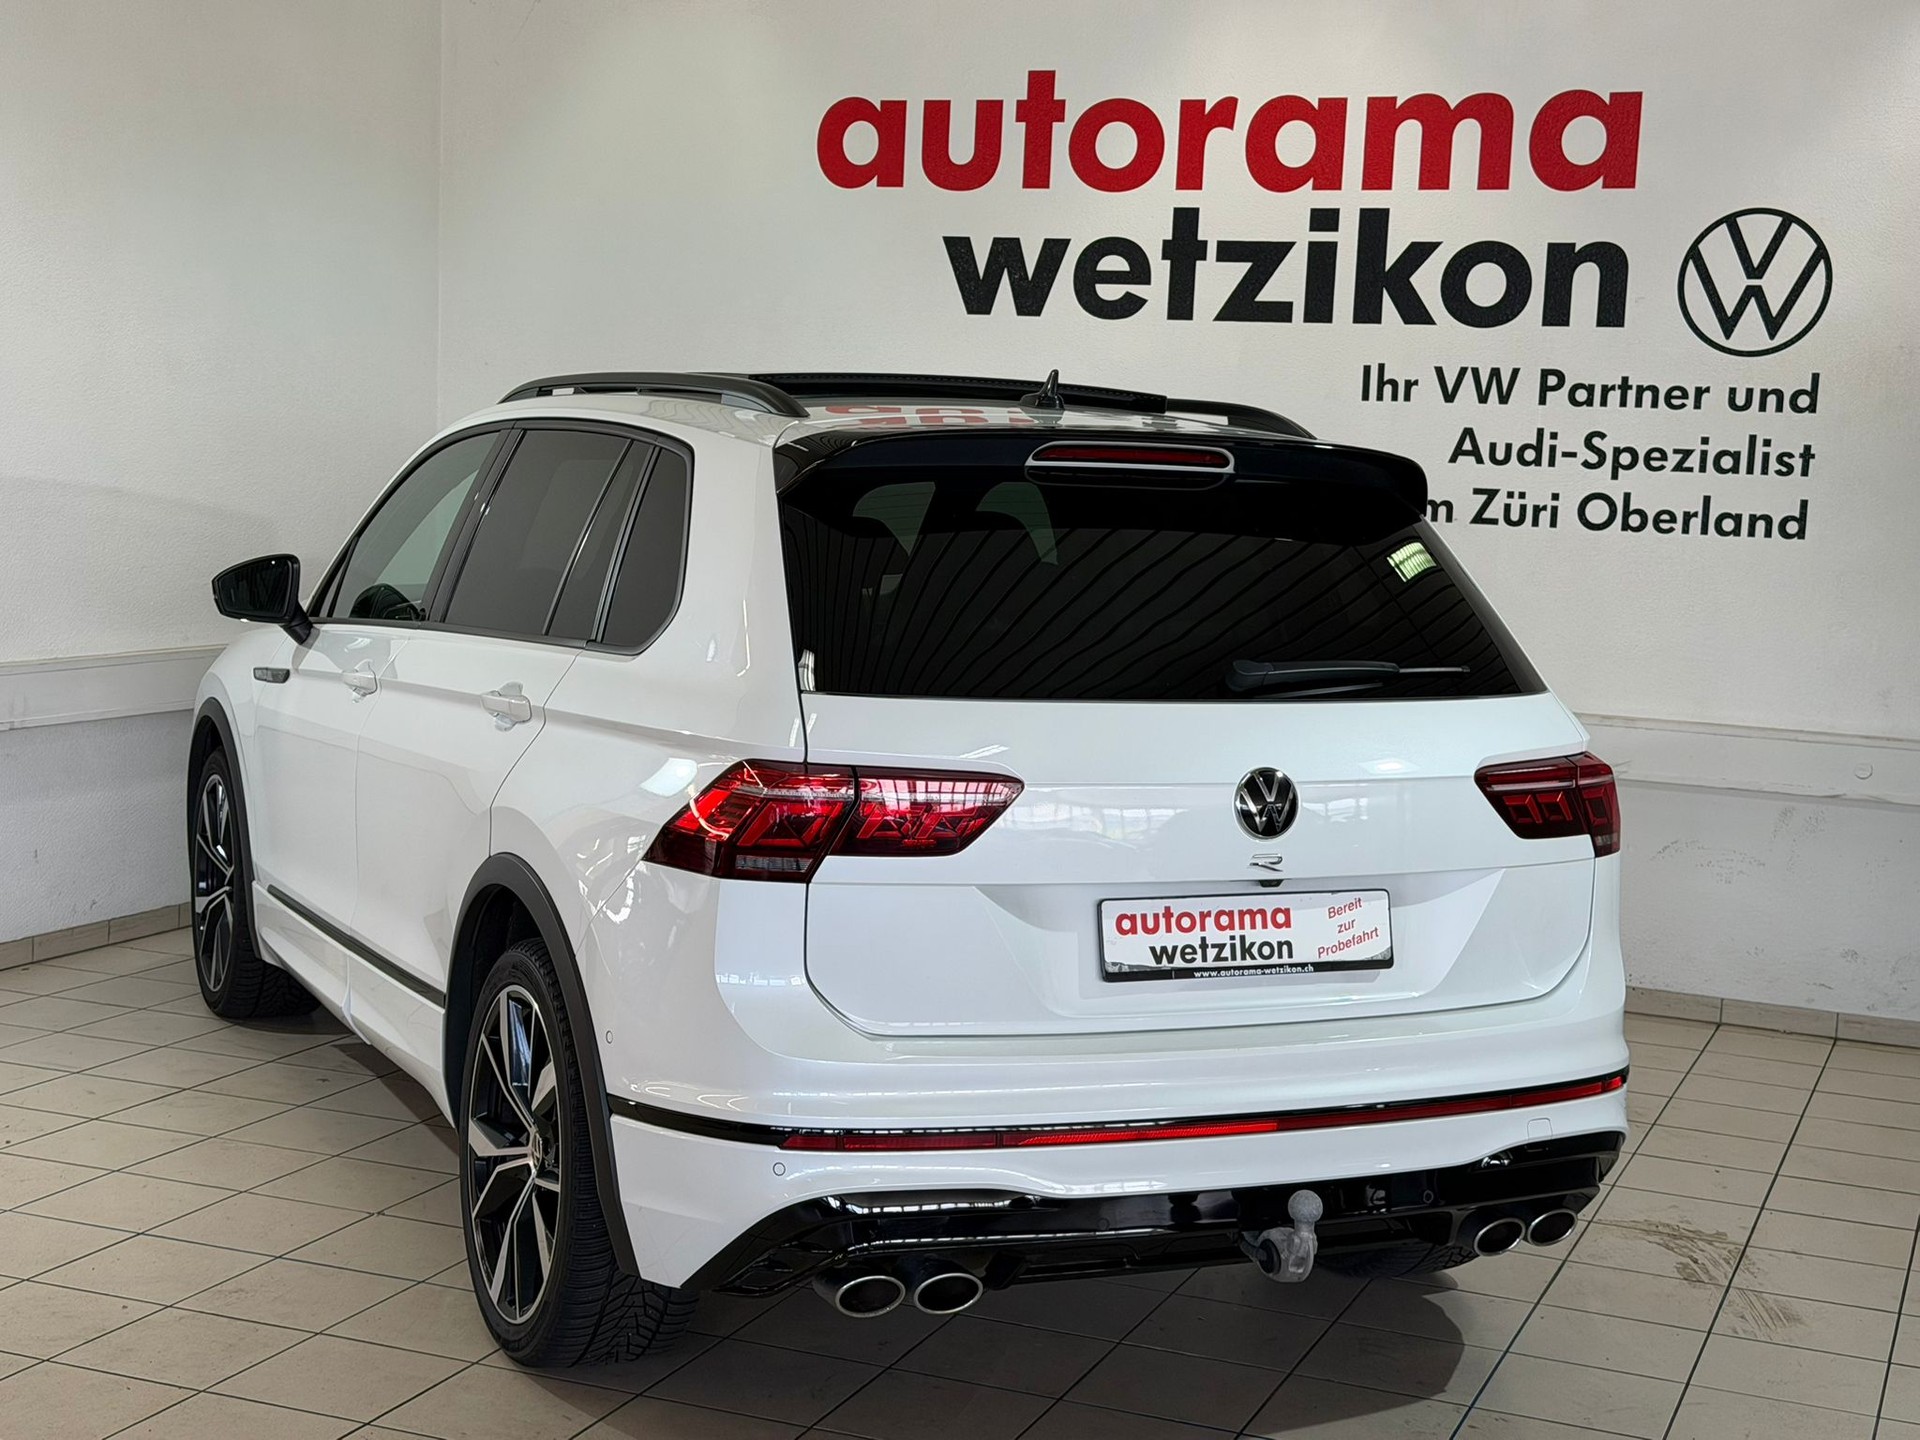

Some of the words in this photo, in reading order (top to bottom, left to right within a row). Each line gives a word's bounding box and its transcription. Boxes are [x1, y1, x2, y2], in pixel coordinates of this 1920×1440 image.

[817, 70, 1643, 193] autorama
[942, 206, 1629, 329] wetzikon
[1361, 362, 1419, 402] Ihr
[1433, 365, 1521, 405] VW
[1538, 368, 1711, 411] Partner
[1727, 372, 1821, 414] und
[1447, 426, 1816, 481] Audi-Spezialist
[1427, 499, 1454, 523] m
[1469, 487, 1560, 529] Züri
[1577, 491, 1809, 541] Oberland
[1115, 905, 1292, 936] autorama
[1327, 896, 1363, 920] Bereit
[1316, 926, 1379, 959] Probefahrt
[1336, 917, 1357, 935] zur
[1148, 934, 1294, 966] wetzikon
[1193, 964, 1315, 978] www.autorama-wetzikon.ch
